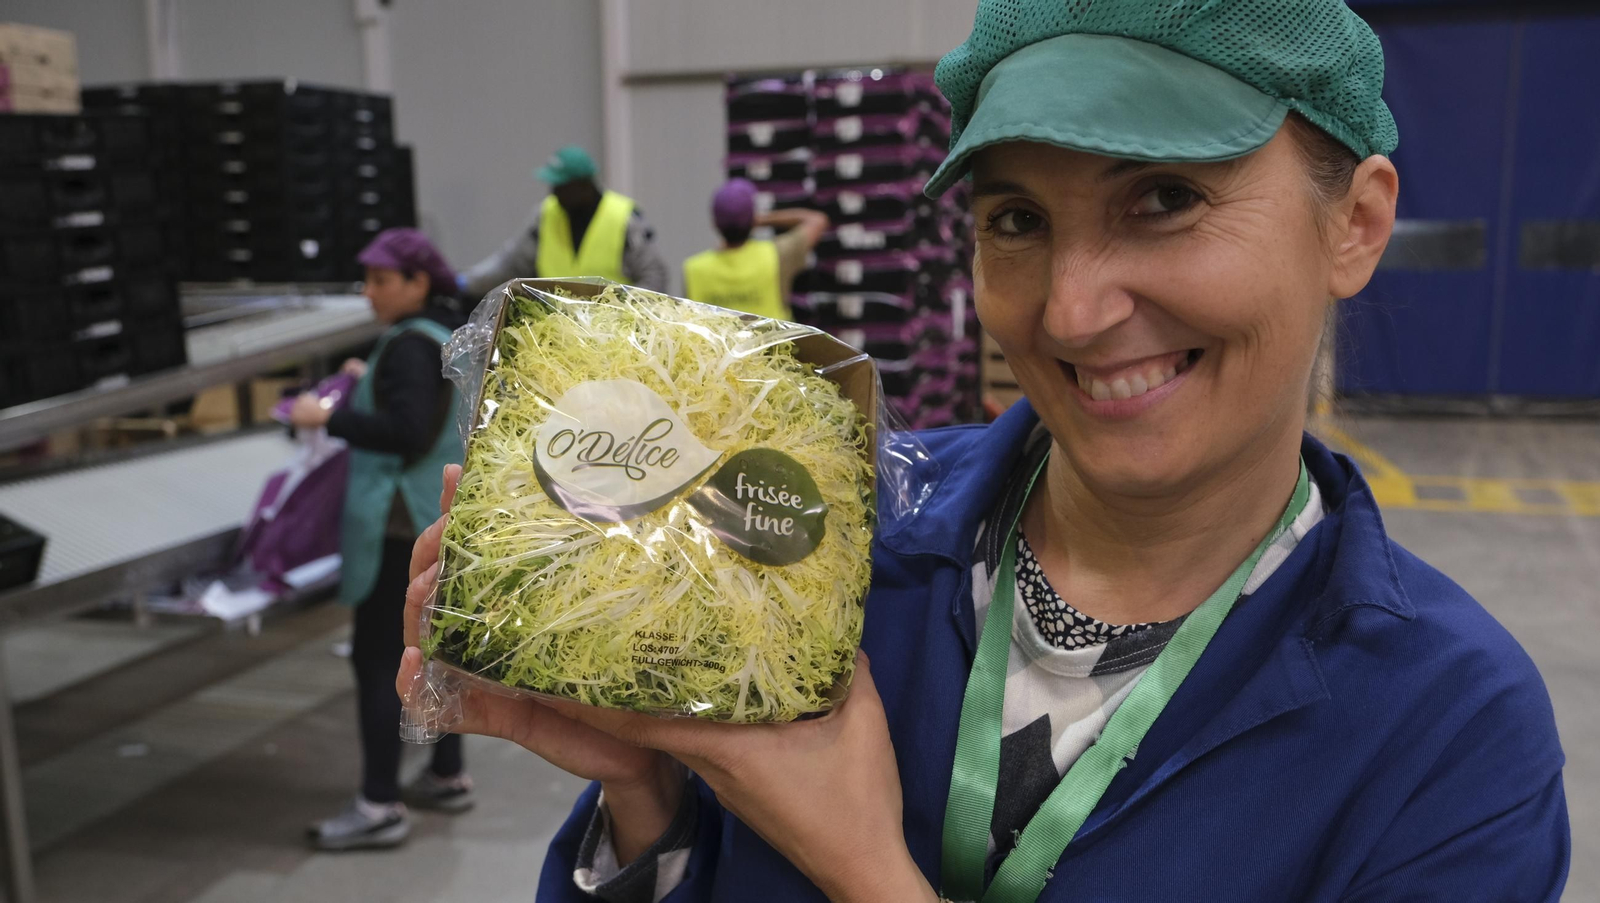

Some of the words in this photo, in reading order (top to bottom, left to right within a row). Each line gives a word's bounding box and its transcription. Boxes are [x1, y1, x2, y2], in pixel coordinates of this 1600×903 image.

[547, 418, 680, 481] O'Délice
[735, 472, 804, 509] frisée
[743, 502, 795, 536] fine
[635, 630, 678, 642] KLASSE:
